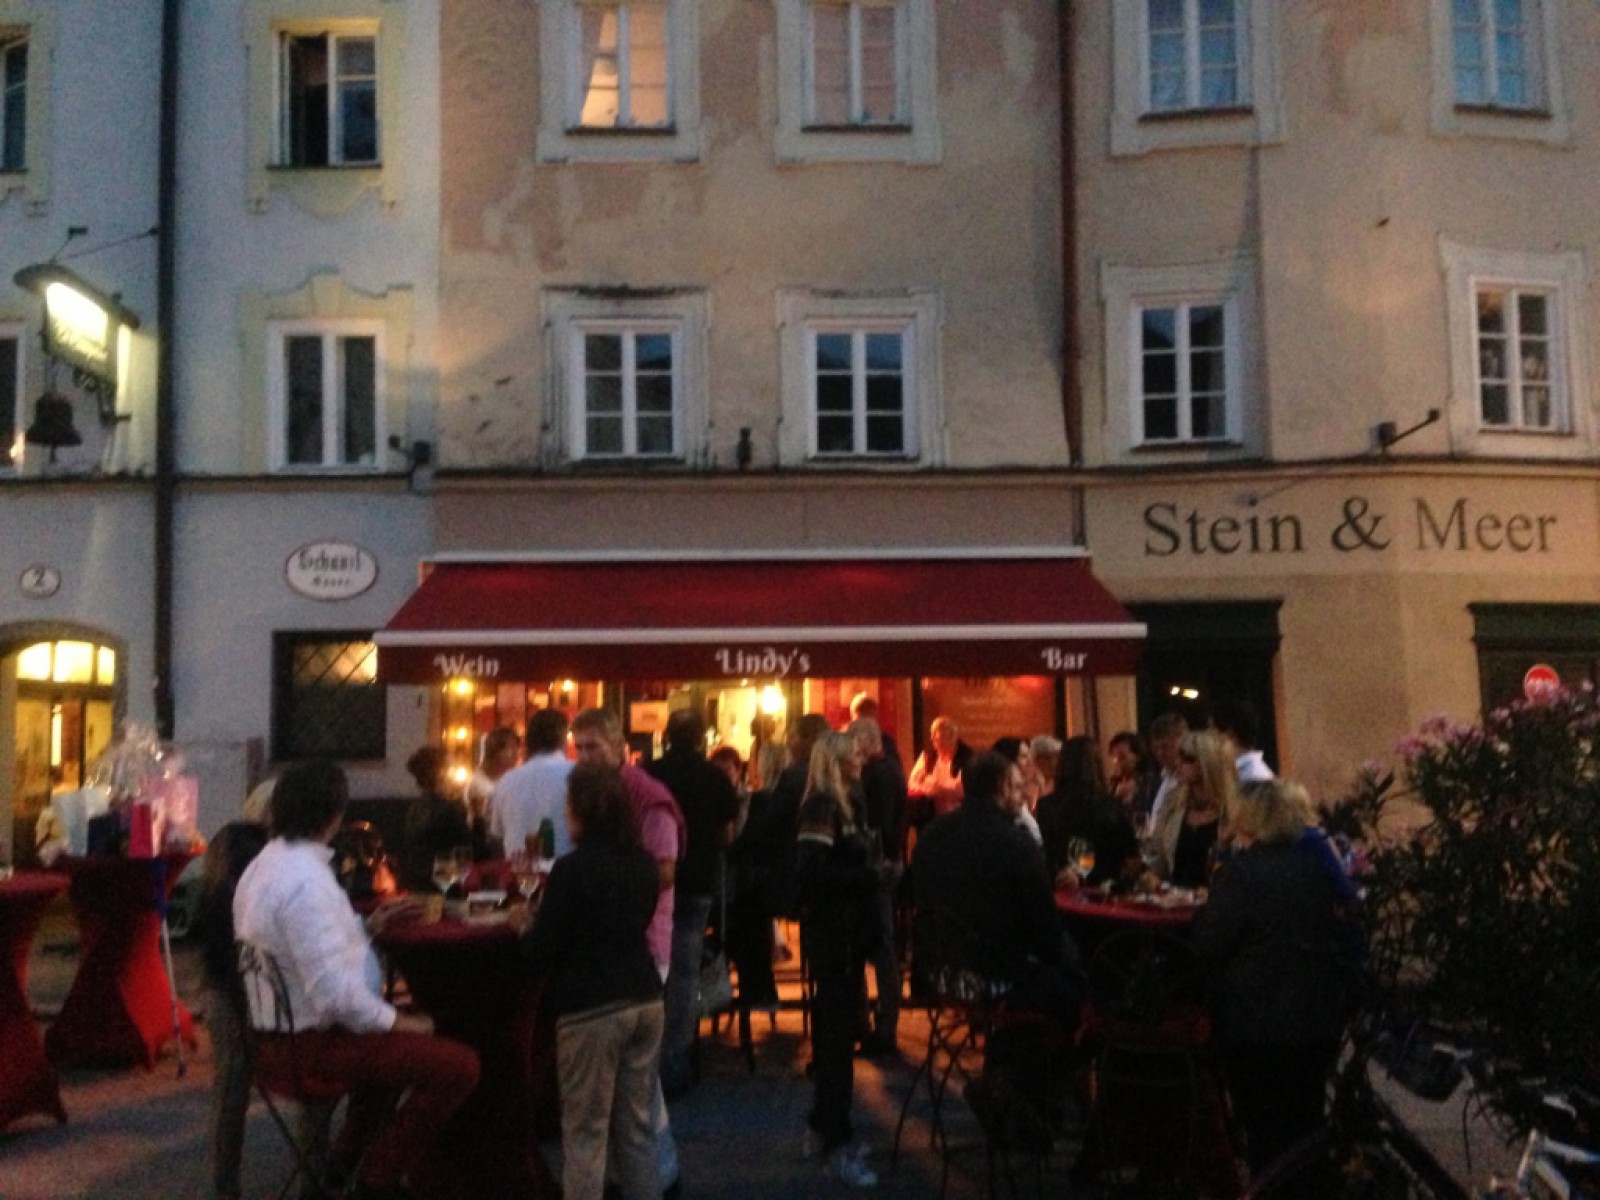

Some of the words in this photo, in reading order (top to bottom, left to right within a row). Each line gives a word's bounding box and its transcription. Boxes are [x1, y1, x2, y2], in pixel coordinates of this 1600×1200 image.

[1143, 497, 1303, 557] Stein
[1330, 495, 1391, 553] &
[1415, 496, 1559, 552] Meer
[433, 653, 501, 678] Wein
[714, 647, 811, 678] Lindy's
[1041, 646, 1088, 671] Bar
